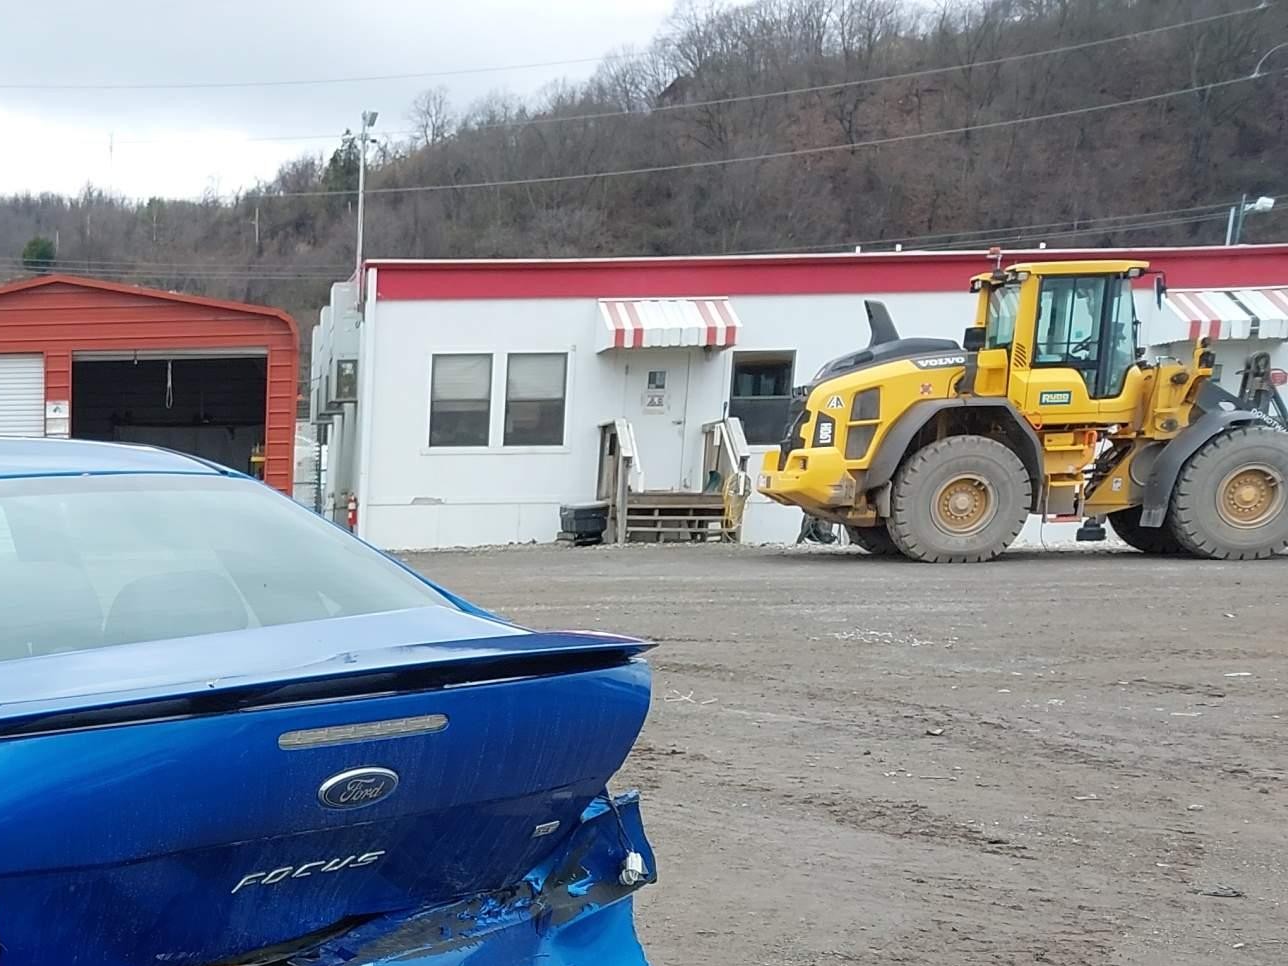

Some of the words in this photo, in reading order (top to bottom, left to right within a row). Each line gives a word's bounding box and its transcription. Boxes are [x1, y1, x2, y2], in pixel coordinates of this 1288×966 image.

[917, 357, 965, 368] VOLVO
[340, 778, 384, 802] Ford
[231, 850, 385, 894] FOCUS
